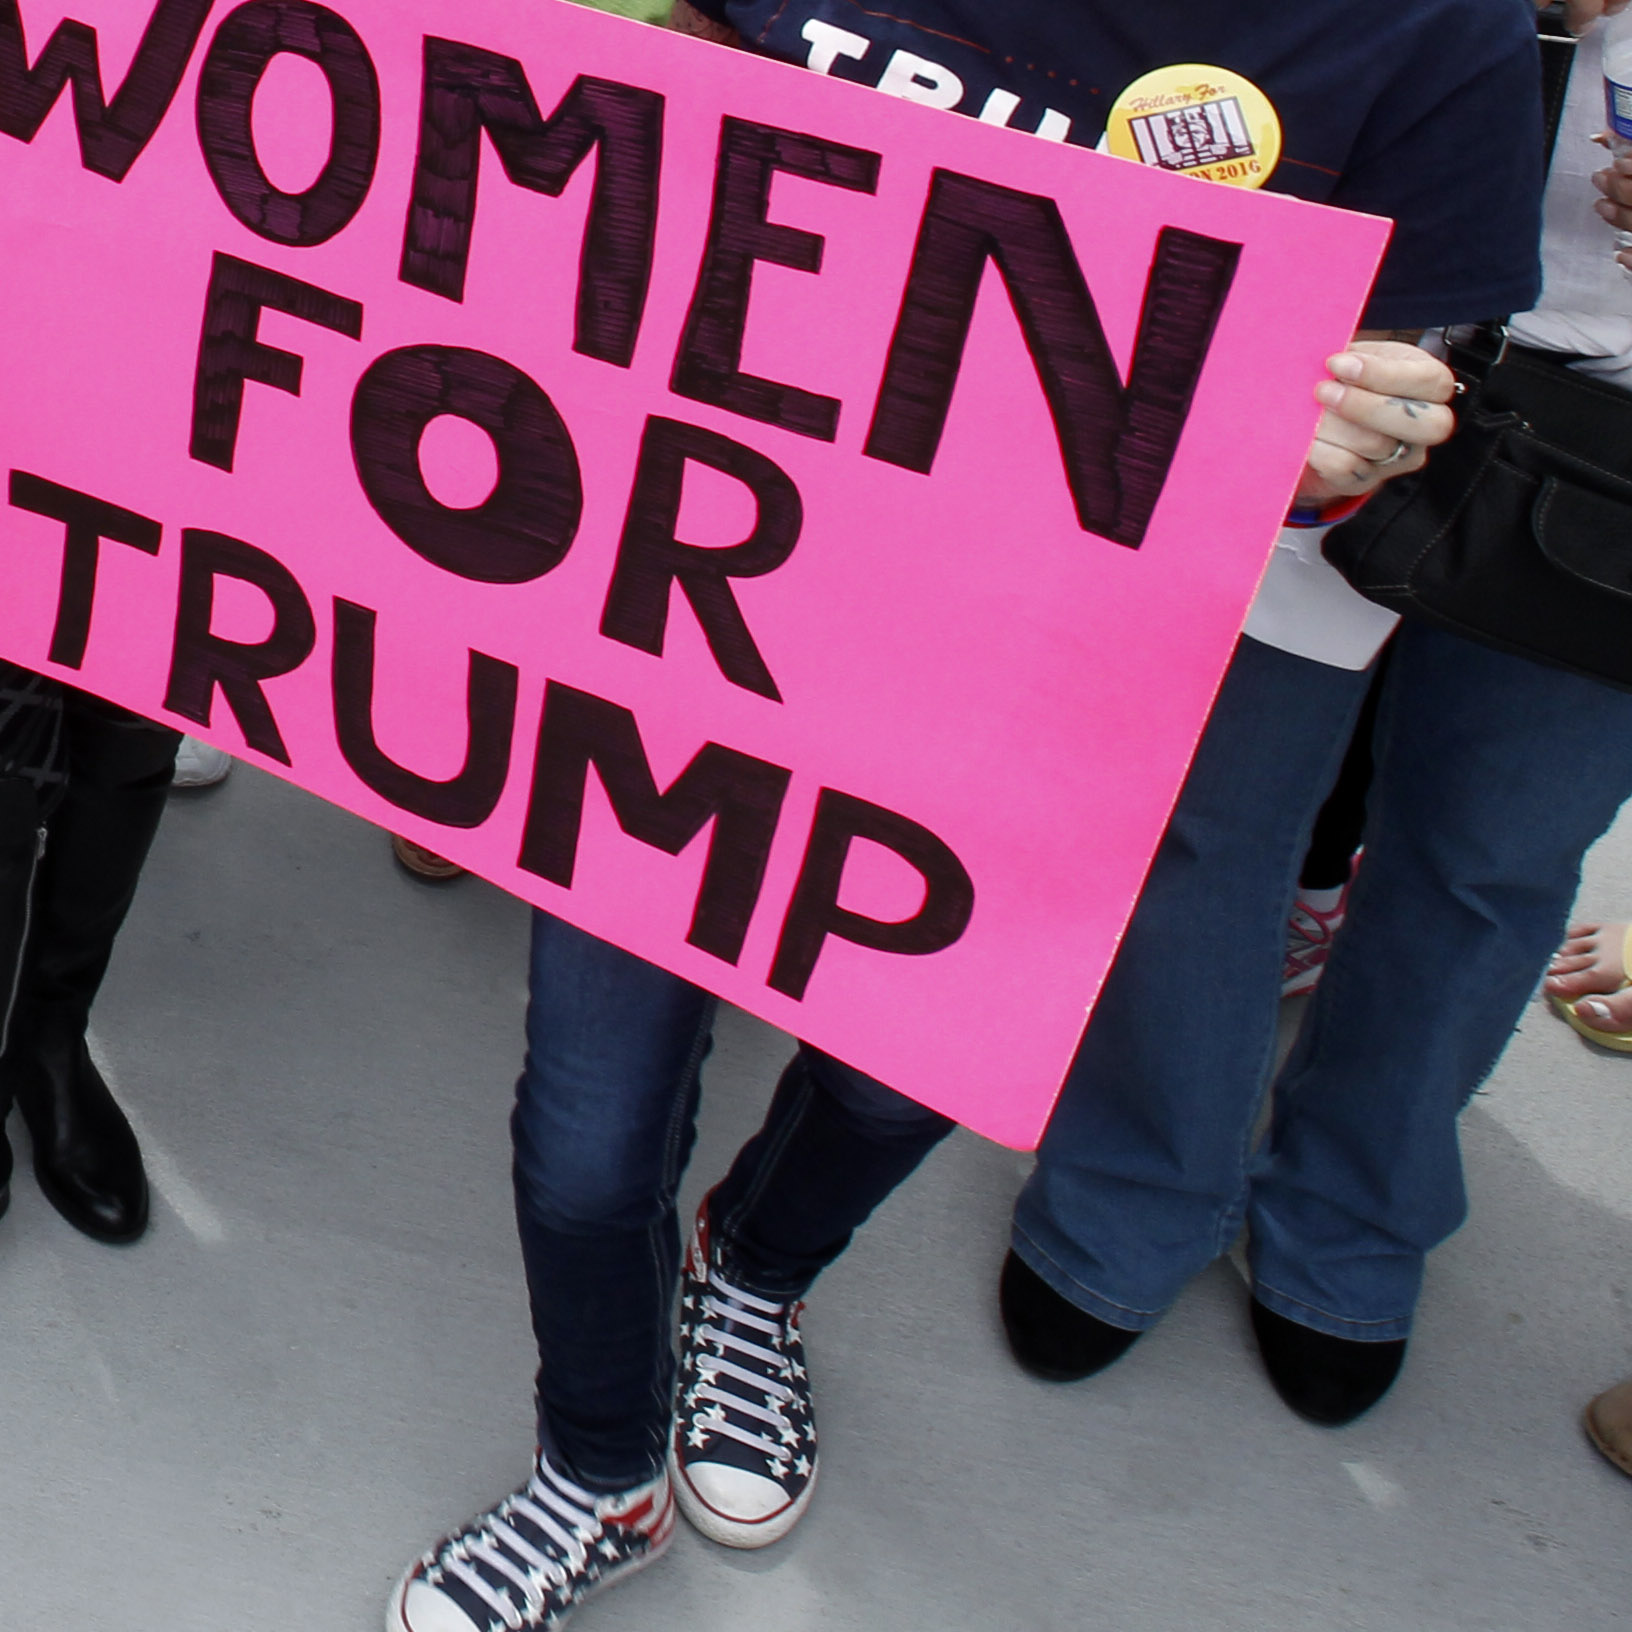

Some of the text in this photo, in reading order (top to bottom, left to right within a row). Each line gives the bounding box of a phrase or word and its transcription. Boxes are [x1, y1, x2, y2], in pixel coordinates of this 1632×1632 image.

[1129, 83, 1226, 112] Hillary For
[1216, 159, 1262, 181] 2016
[190, 251, 802, 704] FOR
[8, 469, 975, 1003] TRUMP
